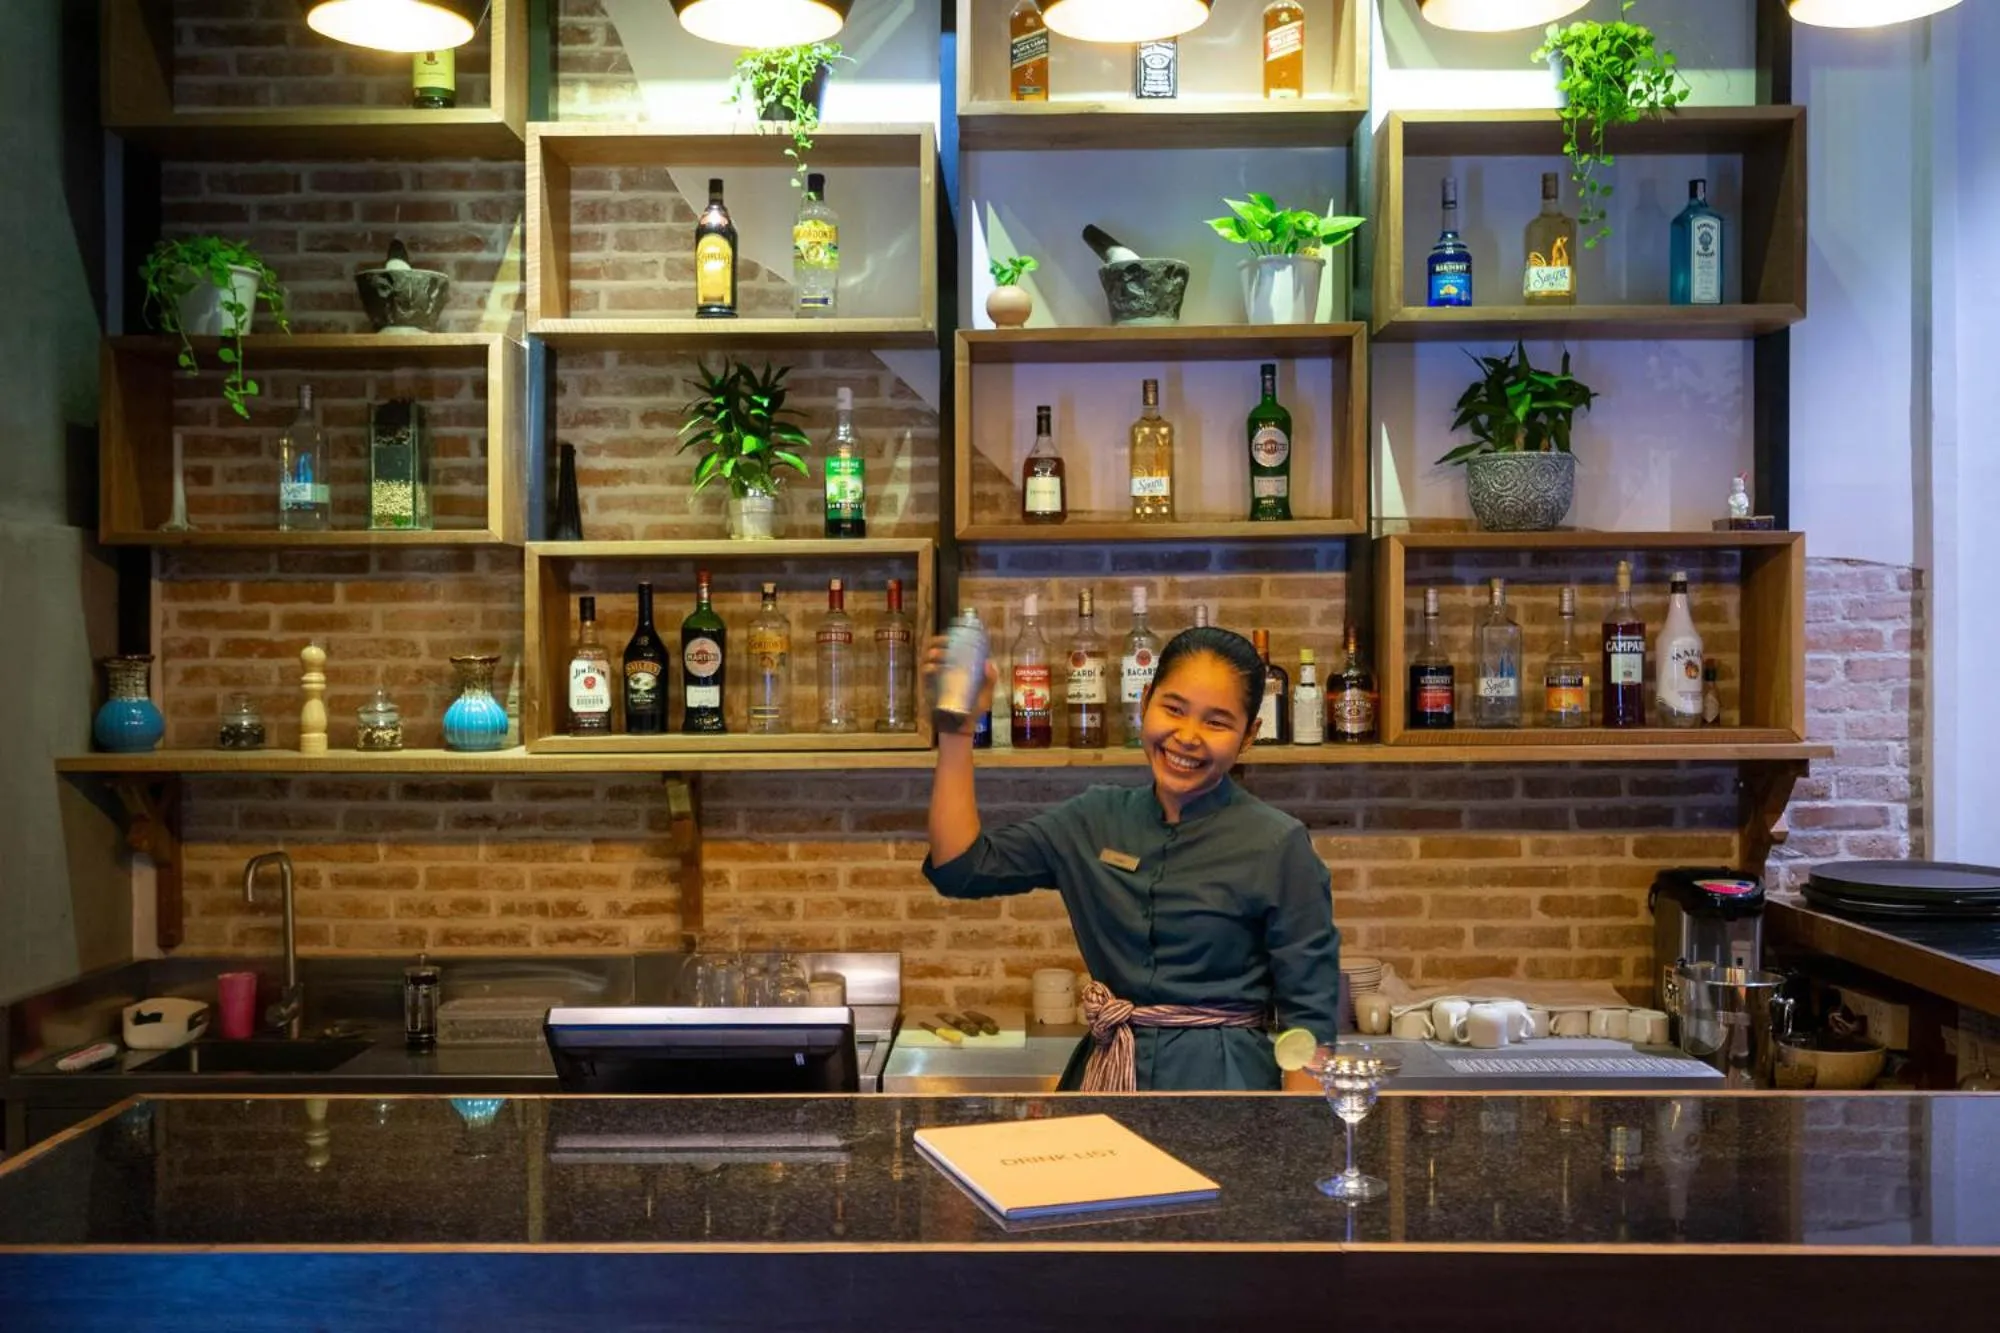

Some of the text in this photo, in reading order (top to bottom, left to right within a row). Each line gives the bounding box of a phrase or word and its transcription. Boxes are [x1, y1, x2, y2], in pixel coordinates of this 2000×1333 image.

[1605, 640, 1646, 653] CAMPAR
[999, 1148, 1119, 1166] DRINK LIST
